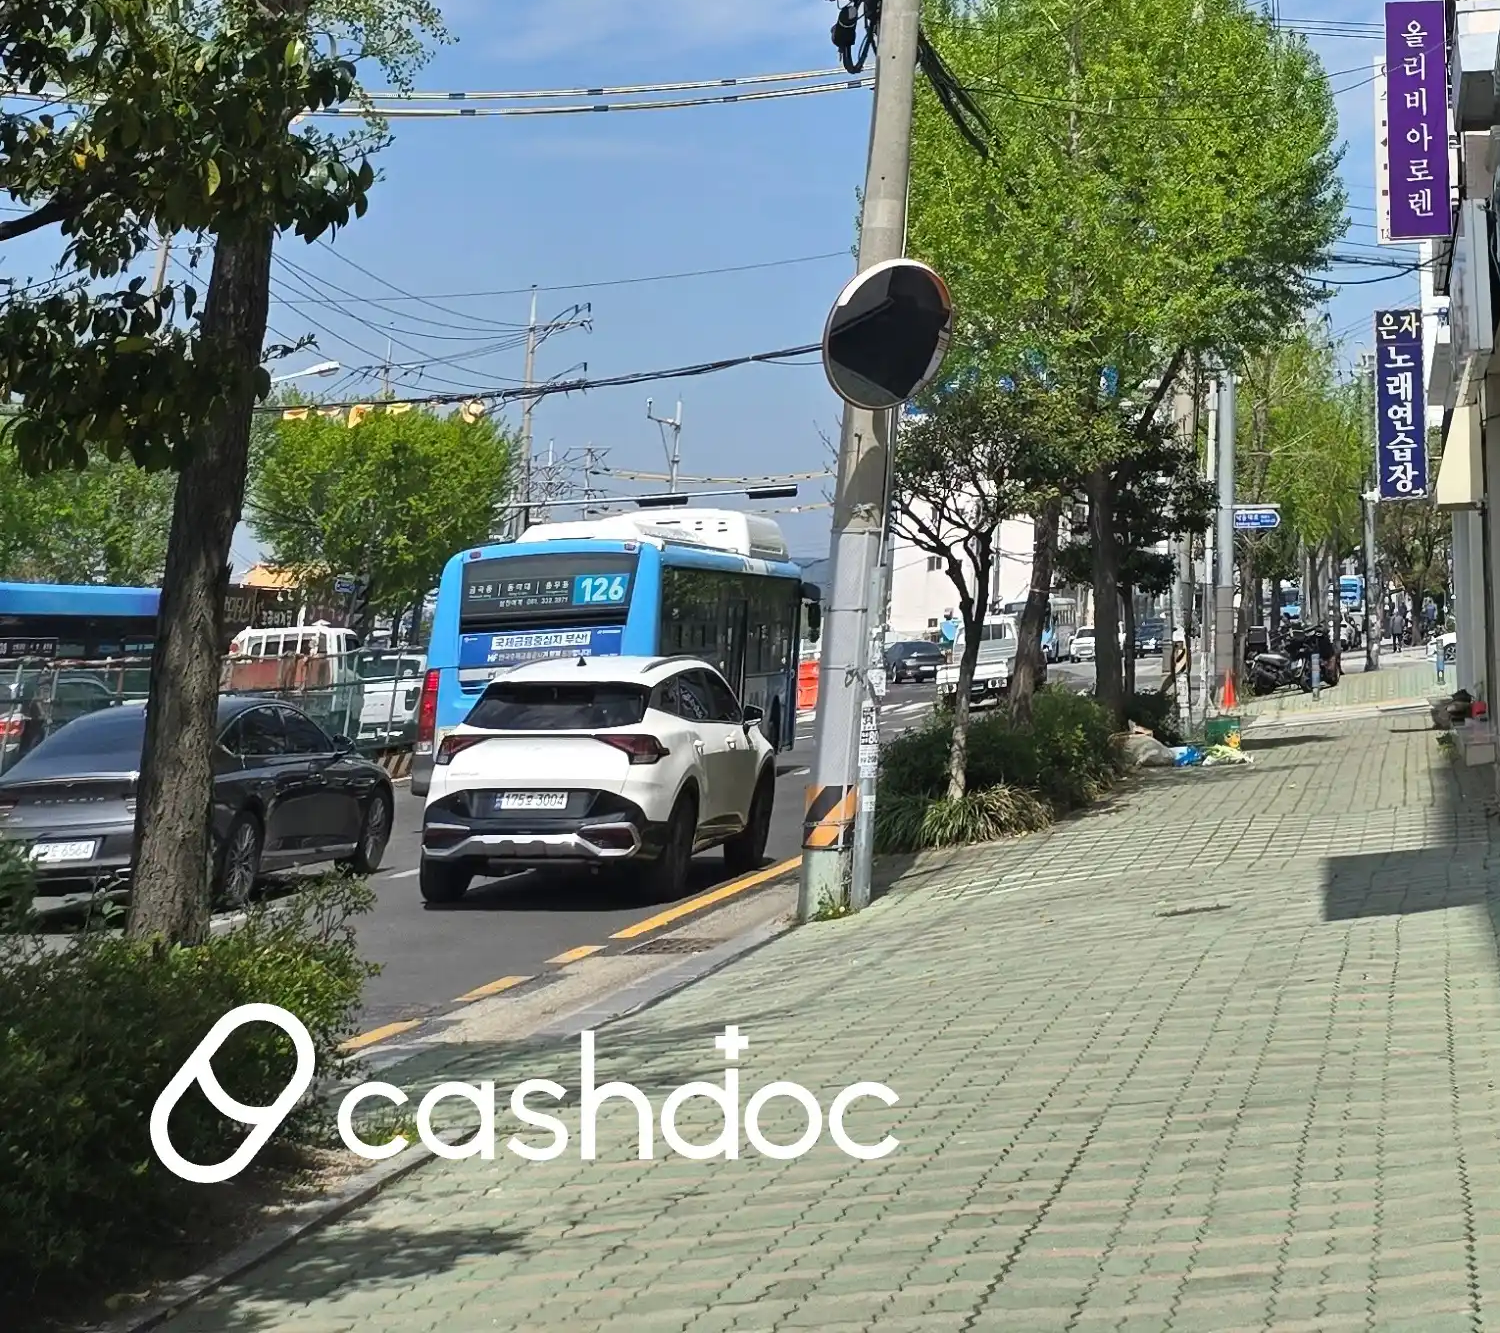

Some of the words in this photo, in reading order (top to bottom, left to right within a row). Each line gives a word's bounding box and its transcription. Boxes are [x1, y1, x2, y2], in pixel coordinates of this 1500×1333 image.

[1400, 19, 1435, 218] 올리비아로렌
[1377, 312, 1420, 340] 은자
[1384, 346, 1420, 494] 노래연습장
[581, 576, 624, 602] 126
[494, 634, 562, 648] 국제금융중심지
